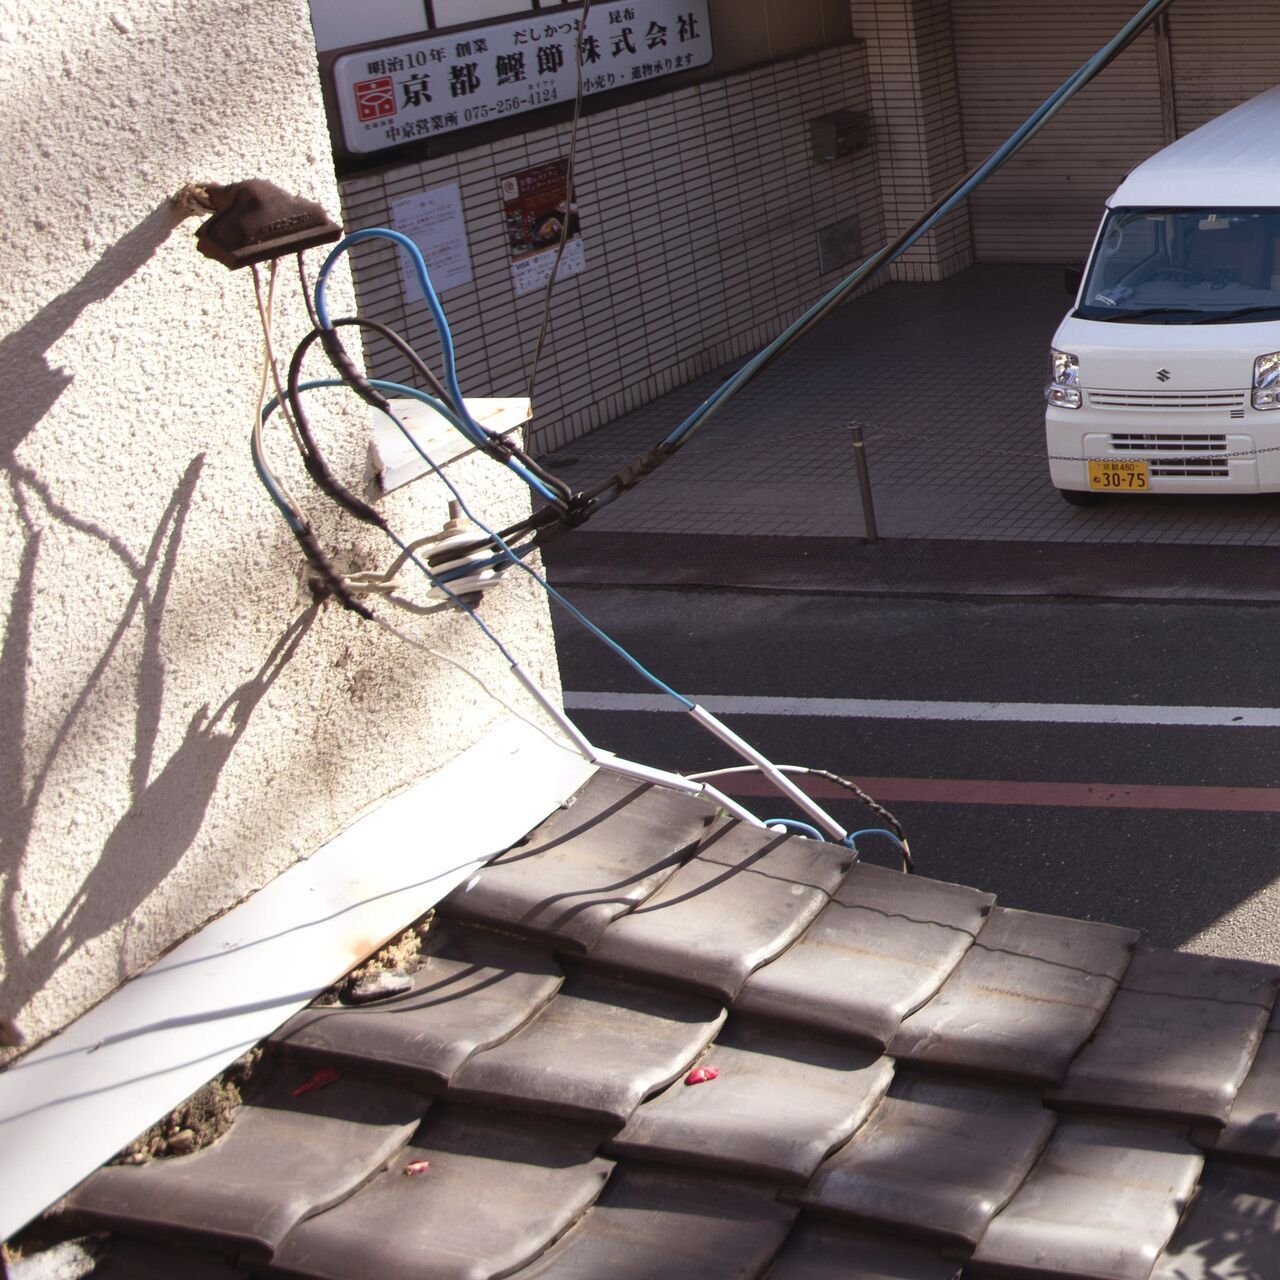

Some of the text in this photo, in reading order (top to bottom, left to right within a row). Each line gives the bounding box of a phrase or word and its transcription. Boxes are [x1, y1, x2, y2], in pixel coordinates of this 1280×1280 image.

[609, 7, 636, 24] 昆布
[398, 12, 700, 110] 京都鰹節株式会社
[385, 87, 558, 143] 中京営業所 075-256-4124
[1102, 472, 1146, 487] 30-75
